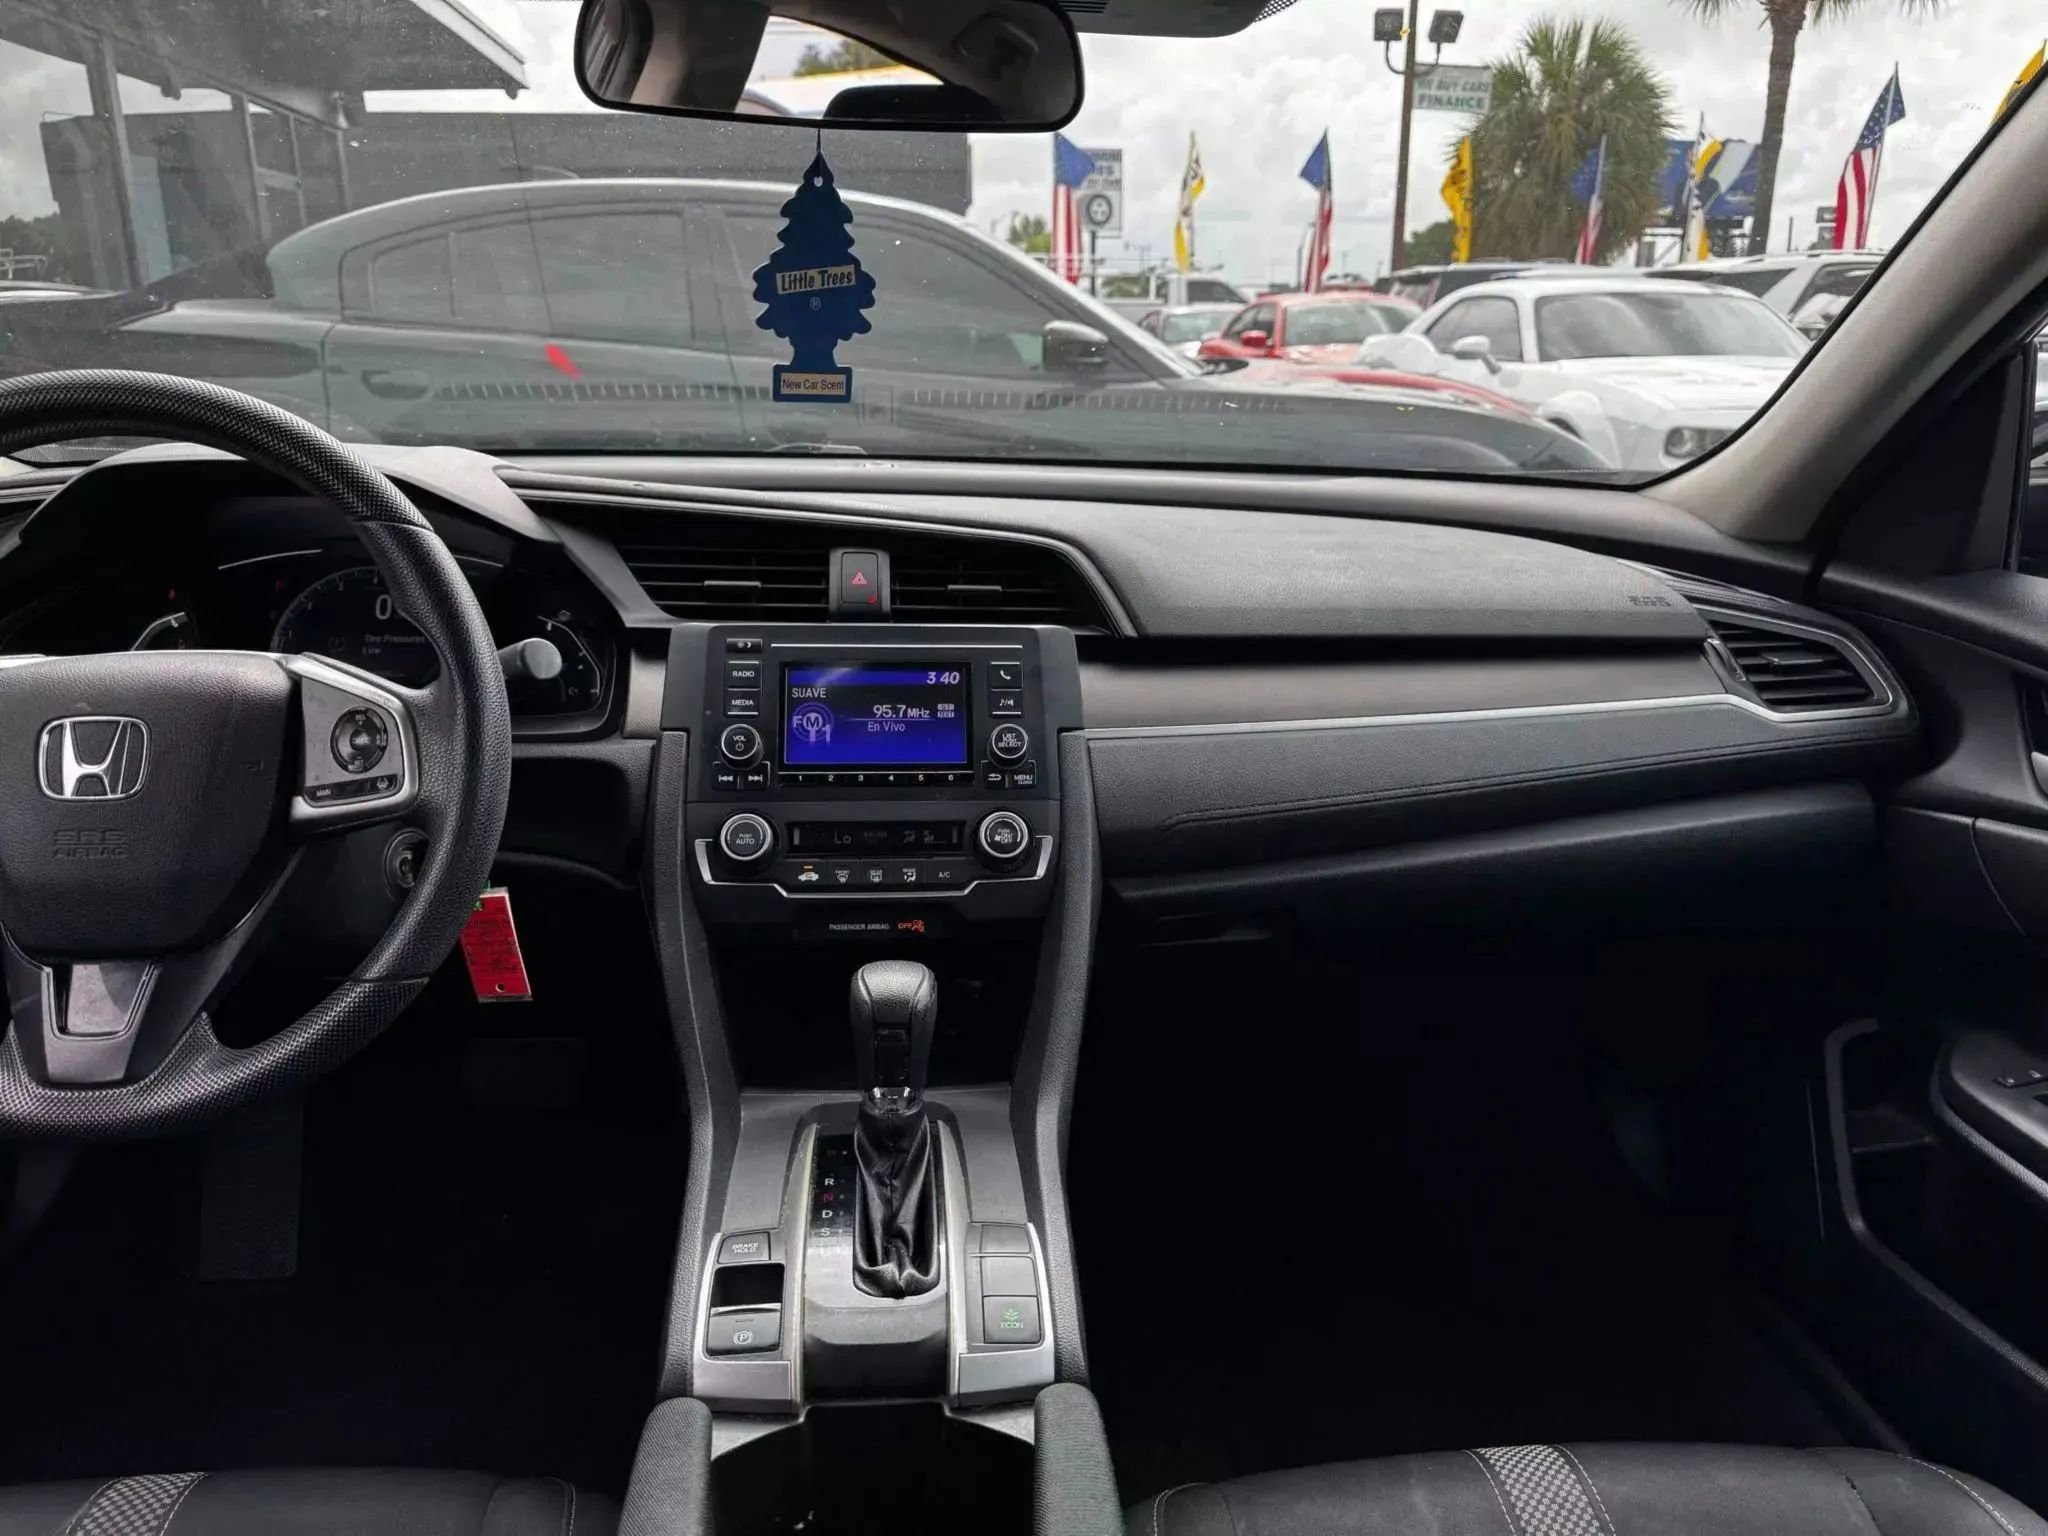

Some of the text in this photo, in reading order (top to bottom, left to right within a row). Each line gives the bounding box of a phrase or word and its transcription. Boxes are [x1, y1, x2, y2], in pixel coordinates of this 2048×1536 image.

[1418, 94, 1485, 108] FINANCE
[780, 269, 852, 290] Little Trees
[782, 378, 845, 392] New Car Scent
[732, 670, 755, 678] RADIO
[792, 688, 827, 698] SUAVE
[732, 698, 754, 707] MEDIA
[868, 722, 906, 732] En Vivo
[824, 1178, 835, 1186] R
[823, 1193, 834, 1202] N
[822, 1210, 833, 1218] D
[820, 1228, 831, 1236] S
